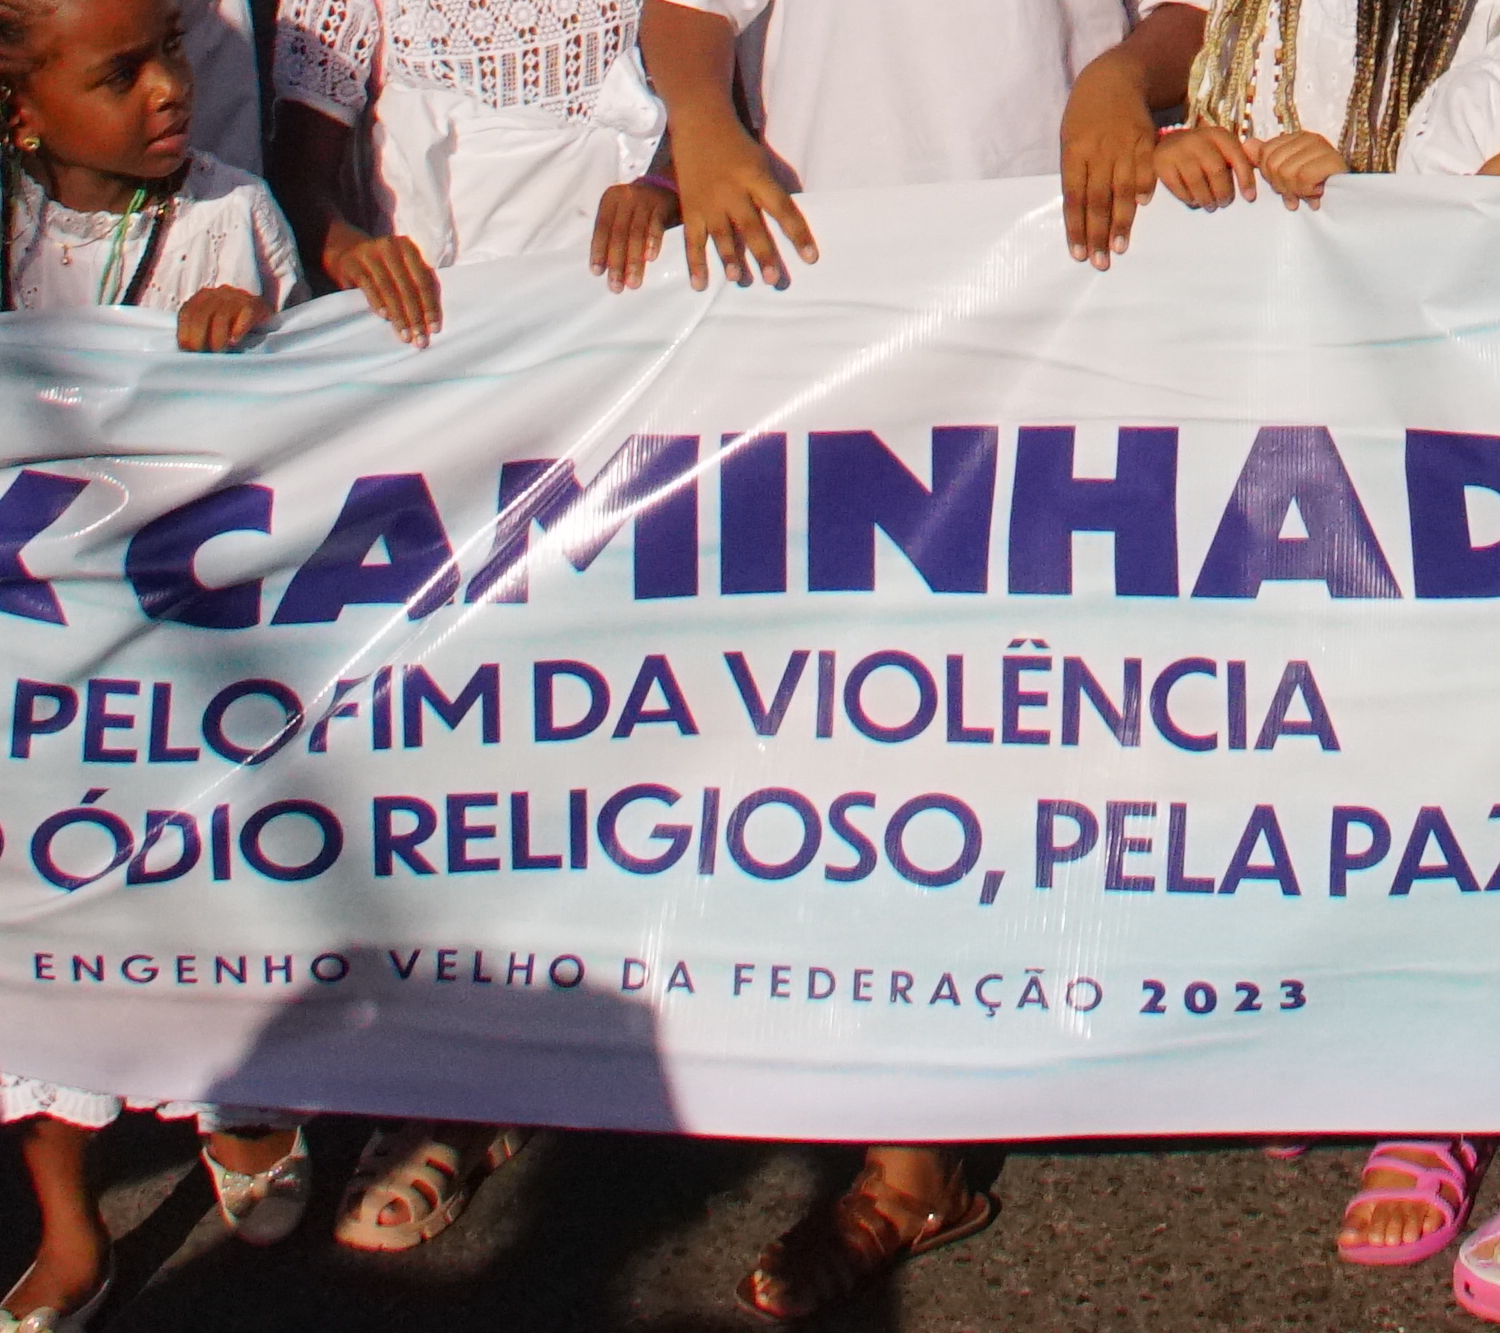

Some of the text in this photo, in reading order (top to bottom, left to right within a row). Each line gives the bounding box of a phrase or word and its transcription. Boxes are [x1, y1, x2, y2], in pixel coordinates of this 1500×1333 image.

[9, 637, 1342, 766] PELO FIM DA VIOLÊNCIA
[30, 786, 345, 893] ÓDIO
[372, 782, 1007, 907] RELIGIOSO,
[1034, 797, 1301, 898] PELA
[33, 946, 1309, 1017] ENGENHO VELHO DA FEDERAÇÃO 2023
